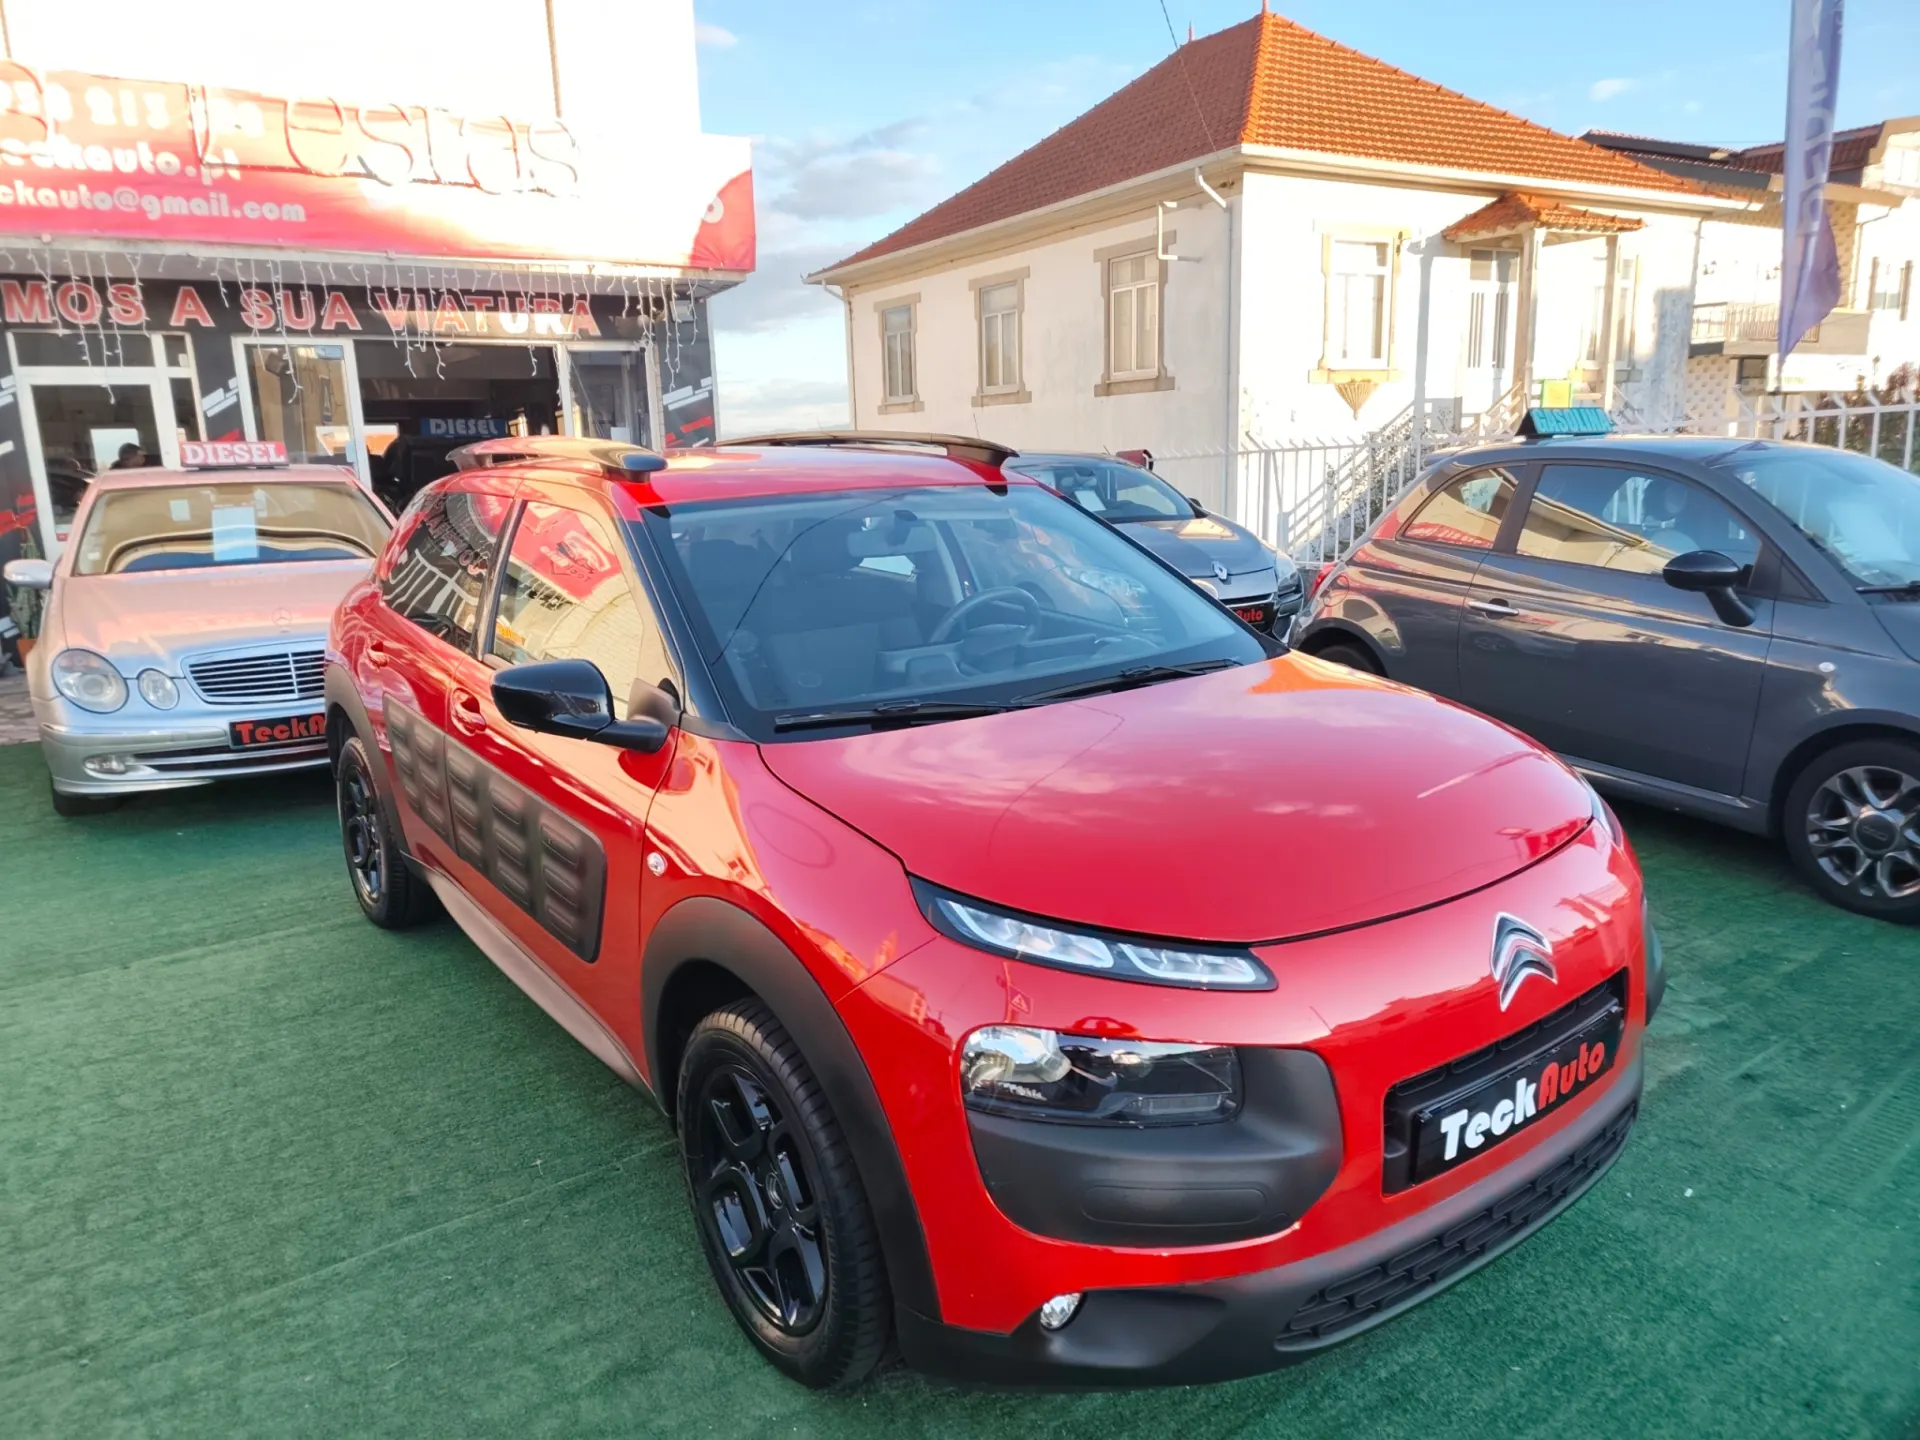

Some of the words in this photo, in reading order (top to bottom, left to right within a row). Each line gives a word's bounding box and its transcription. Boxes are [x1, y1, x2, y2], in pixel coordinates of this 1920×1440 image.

[0, 180, 306, 222] ckauto@gmail.com
[0, 279, 147, 326] MOS
[170, 286, 216, 327] A
[240, 289, 362, 330] SUA
[374, 292, 602, 336] VIATURA
[429, 418, 498, 435] DIESEL
[1533, 406, 1613, 433] GASOLINA
[182, 443, 286, 466] DIESEL
[1440, 1041, 1606, 1161] TeckAuto
